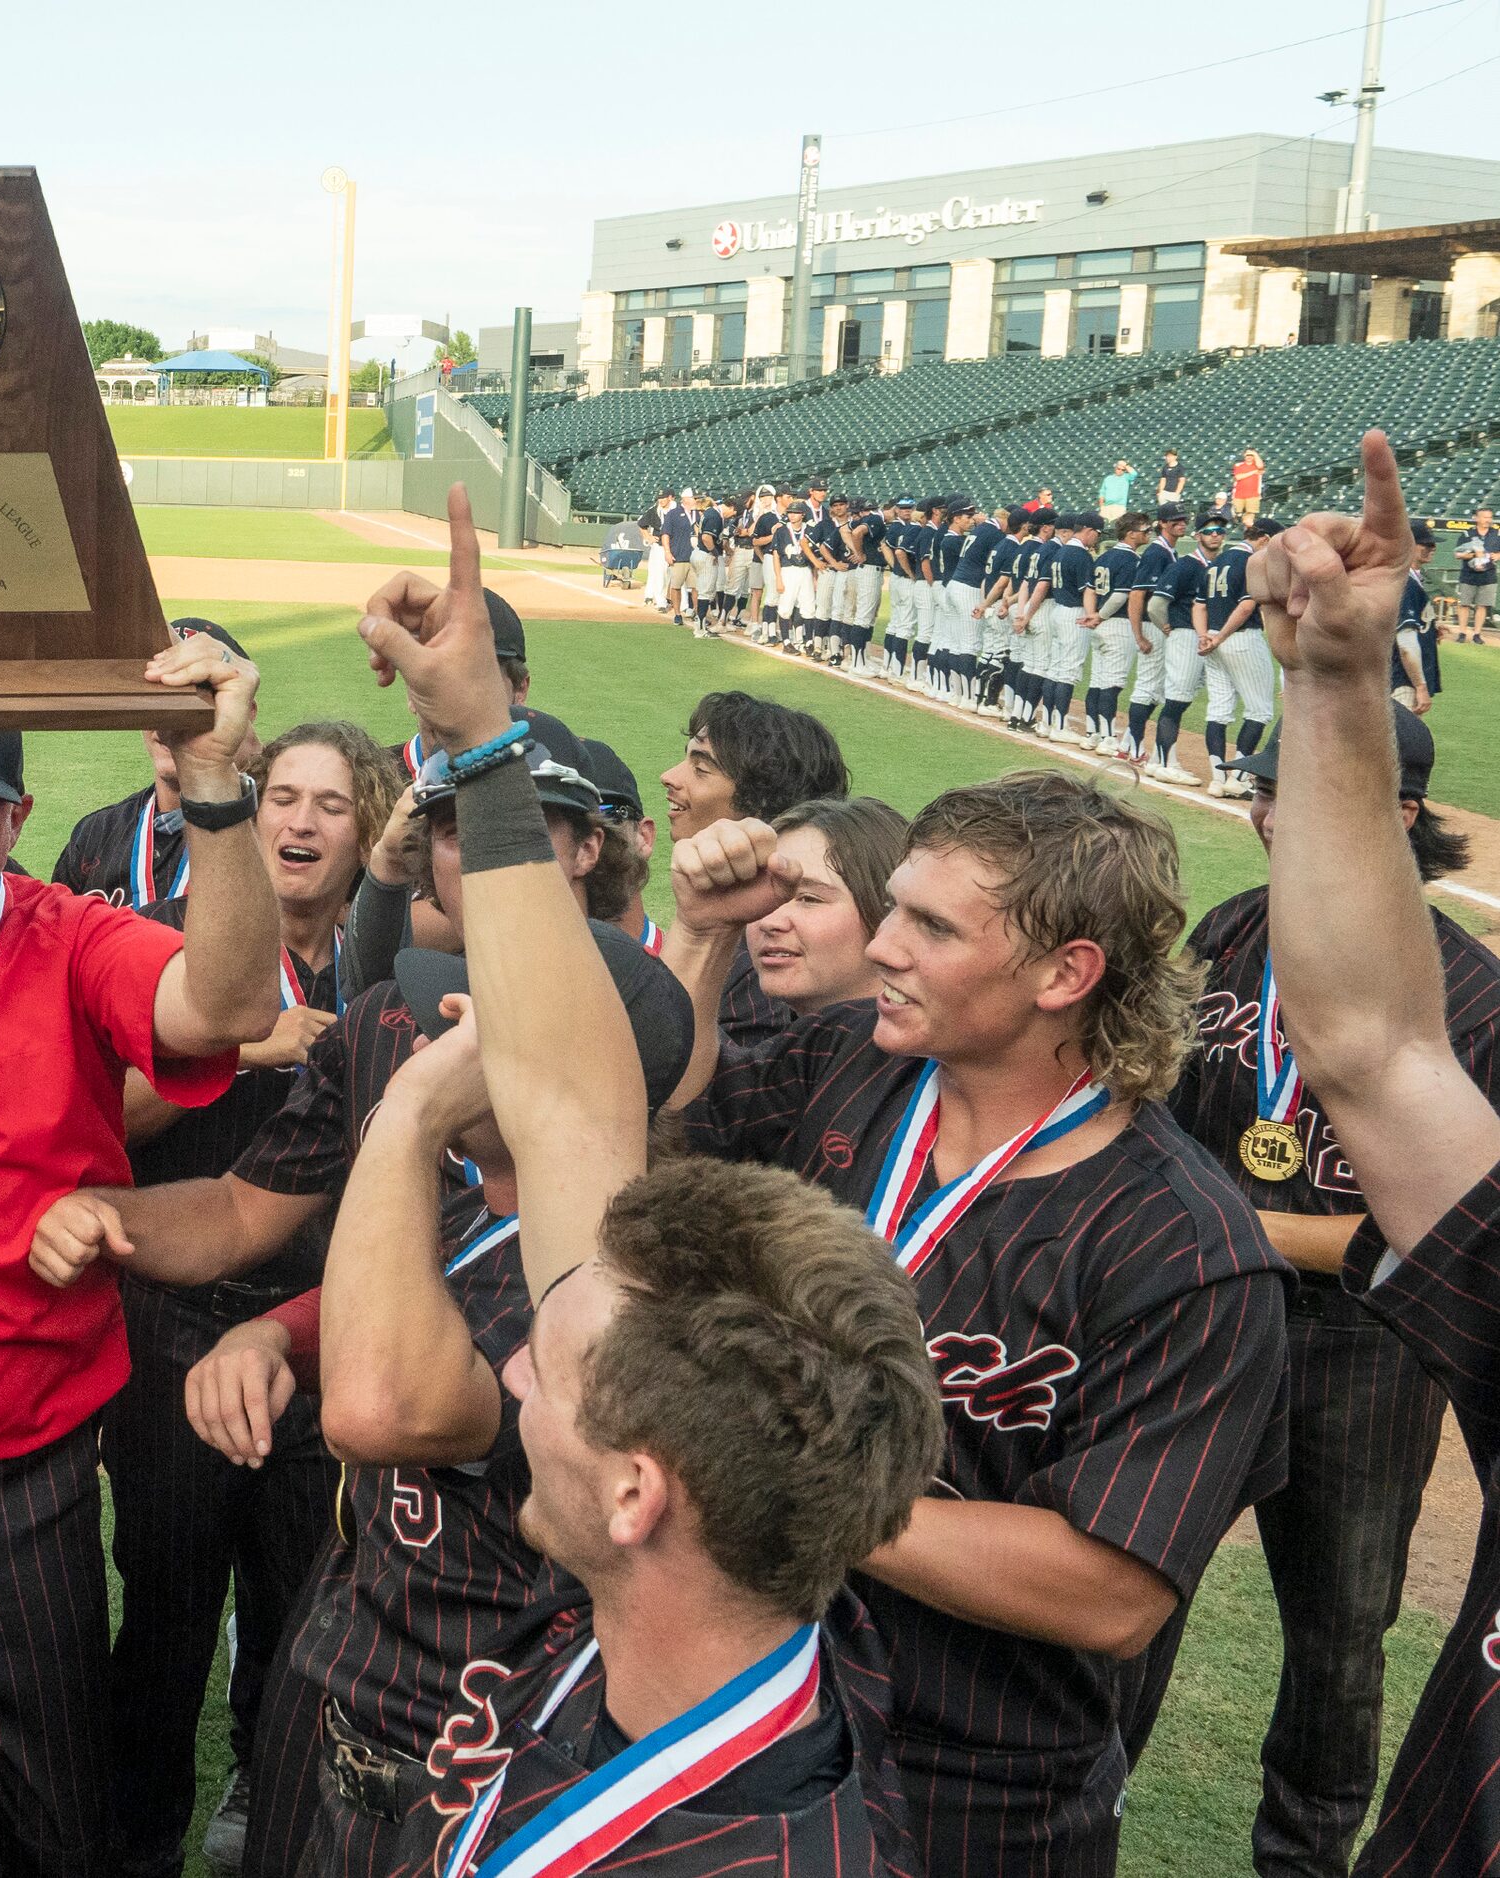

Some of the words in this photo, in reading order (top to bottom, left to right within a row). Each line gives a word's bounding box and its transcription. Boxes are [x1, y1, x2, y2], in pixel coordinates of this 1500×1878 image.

[825, 206, 941, 246] Heritage
[942, 196, 1044, 231] Center
[0, 502, 42, 549] LEAGUE
[1208, 566, 1231, 598] 14
[1256, 1159, 1283, 1170] STATE
[391, 1467, 442, 1548] 5
